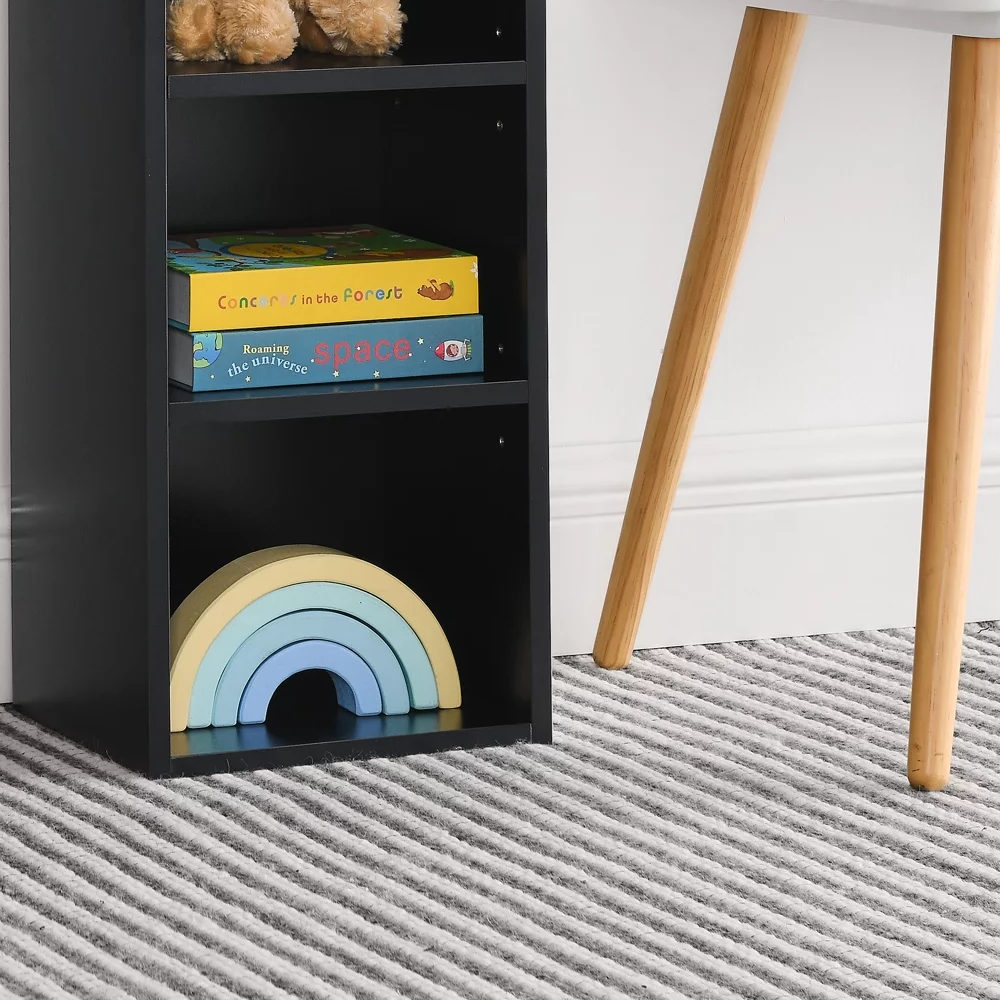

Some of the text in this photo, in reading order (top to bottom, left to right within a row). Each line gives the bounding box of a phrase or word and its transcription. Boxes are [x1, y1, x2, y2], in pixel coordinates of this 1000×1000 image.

[217, 294, 297, 310] Concerts
[302, 294, 313, 305] in
[316, 293, 338, 305] the
[242, 343, 290, 356] Roaming
[314, 338, 412, 371] space
[227, 353, 309, 378] the universe
